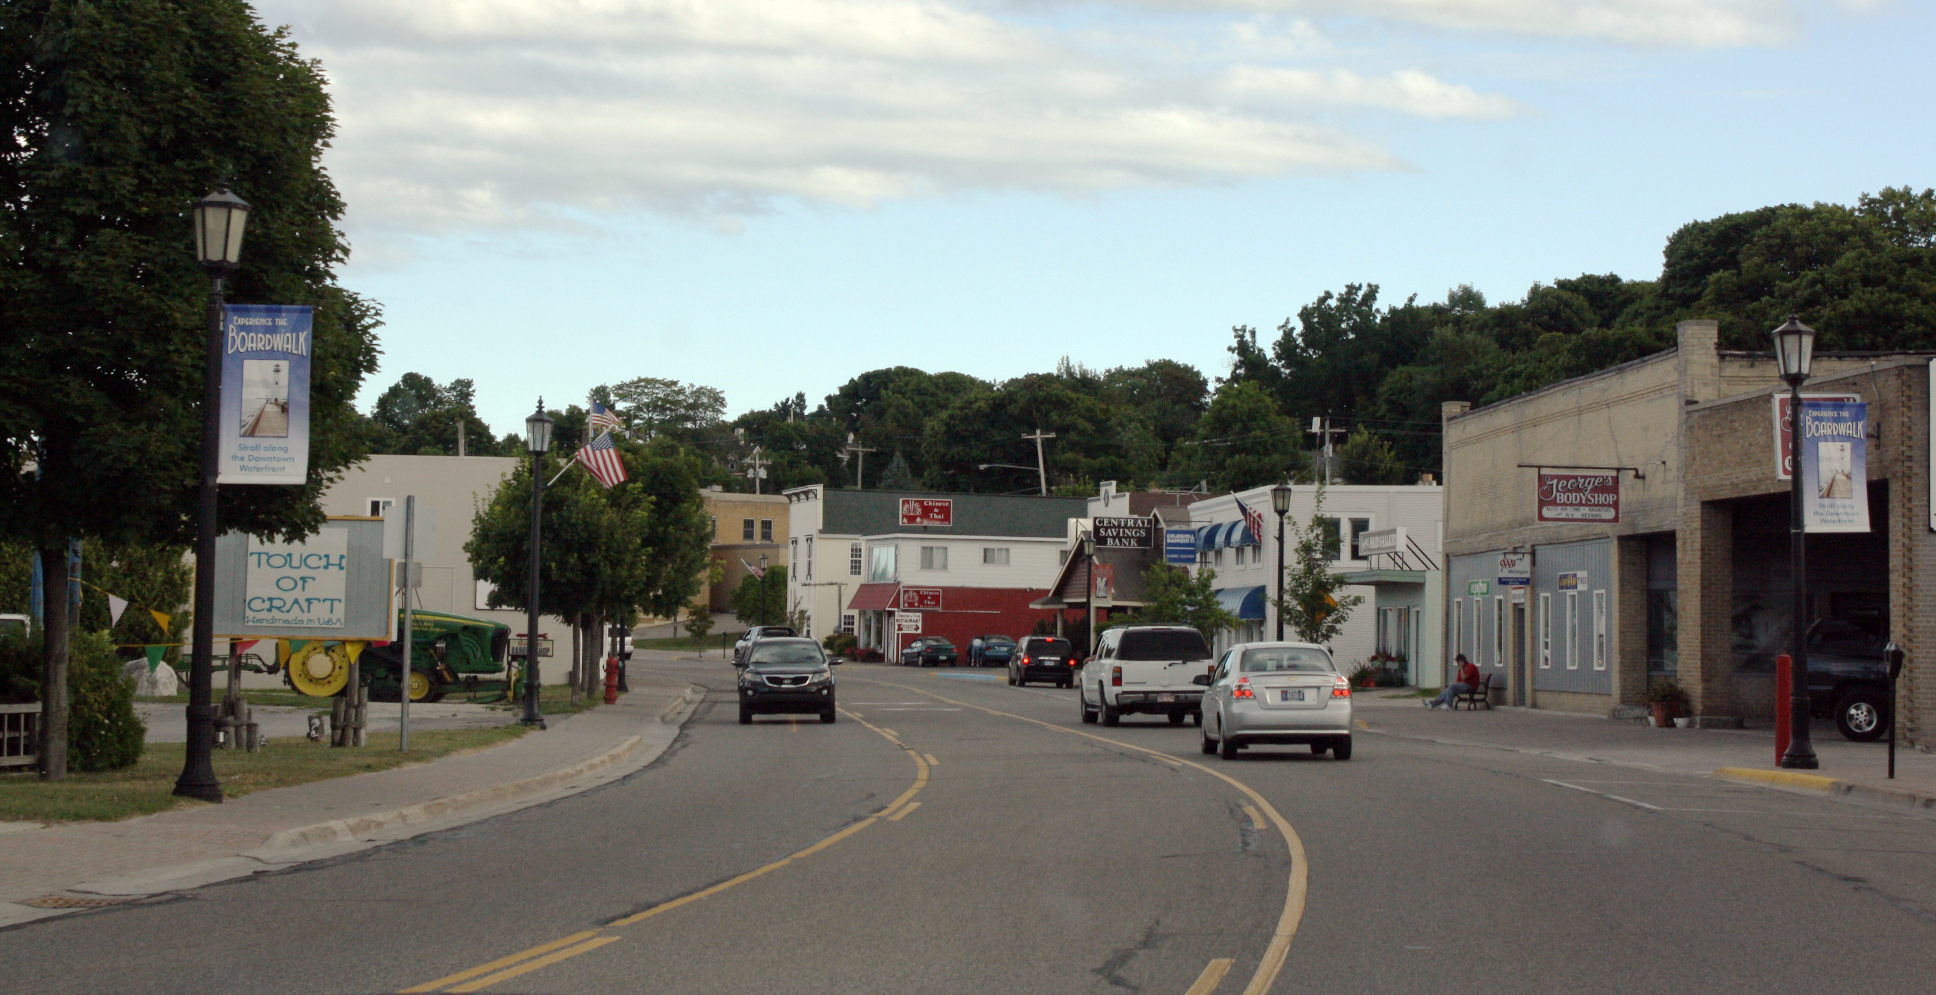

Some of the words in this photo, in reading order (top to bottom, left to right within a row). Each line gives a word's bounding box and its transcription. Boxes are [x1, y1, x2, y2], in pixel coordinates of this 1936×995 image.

[233, 316, 272, 326] EXPERIENCE
[275, 318, 287, 326] THE
[227, 324, 307, 357] BOARDWALK
[1809, 410, 1838, 418] EXPERIENCE
[1805, 416, 1864, 440] BOARDWALK
[238, 444, 261, 452] Stroll
[263, 444, 289, 454] along
[231, 454, 245, 462] the
[248, 454, 295, 463] Downtown
[239, 464, 286, 473] Waterfront
[1539, 475, 1613, 501] George's
[1826, 510, 1859, 518] Downtown
[1095, 517, 1151, 527] CENTRAL
[1099, 528, 1146, 537] SAVINGS
[1106, 538, 1138, 547] BANK
[249, 552, 346, 571] TOUCH
[276, 576, 316, 592] OF
[247, 597, 342, 615] CRAFT
[246, 616, 304, 626] Handmade
[306, 617, 316, 625] in
[317, 617, 343, 626] USA
